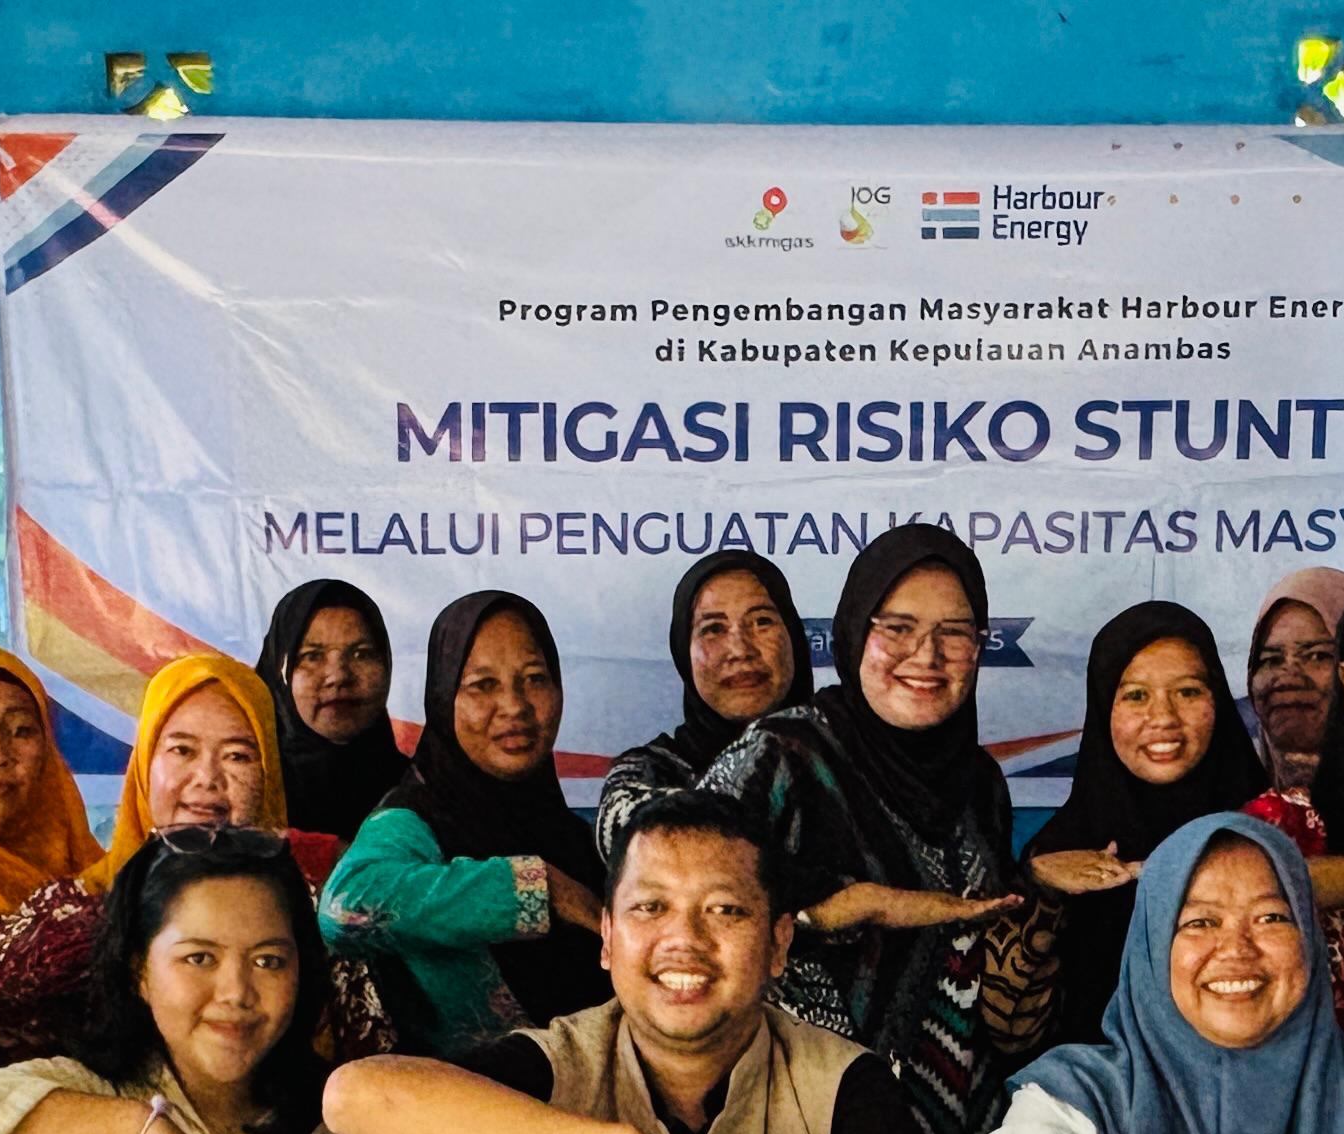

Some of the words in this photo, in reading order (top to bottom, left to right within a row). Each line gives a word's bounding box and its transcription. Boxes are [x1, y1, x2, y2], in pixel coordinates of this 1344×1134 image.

[993, 183, 1106, 211] Harbour
[992, 214, 1089, 247] Energy
[498, 299, 638, 327] Program
[652, 297, 907, 327] Pengembangan
[919, 296, 1110, 325] Masyarakat
[1122, 294, 1258, 319] Harbour
[654, 337, 686, 363] di
[698, 338, 877, 368] Kabupaten
[889, 338, 1065, 367] Kepulauan
[1077, 336, 1231, 361] Anambas
[396, 401, 750, 463] MITIGASI
[778, 399, 1051, 463] RISIKO
[263, 511, 500, 555] MELALUI
[519, 511, 869, 555] PENGUATAN
